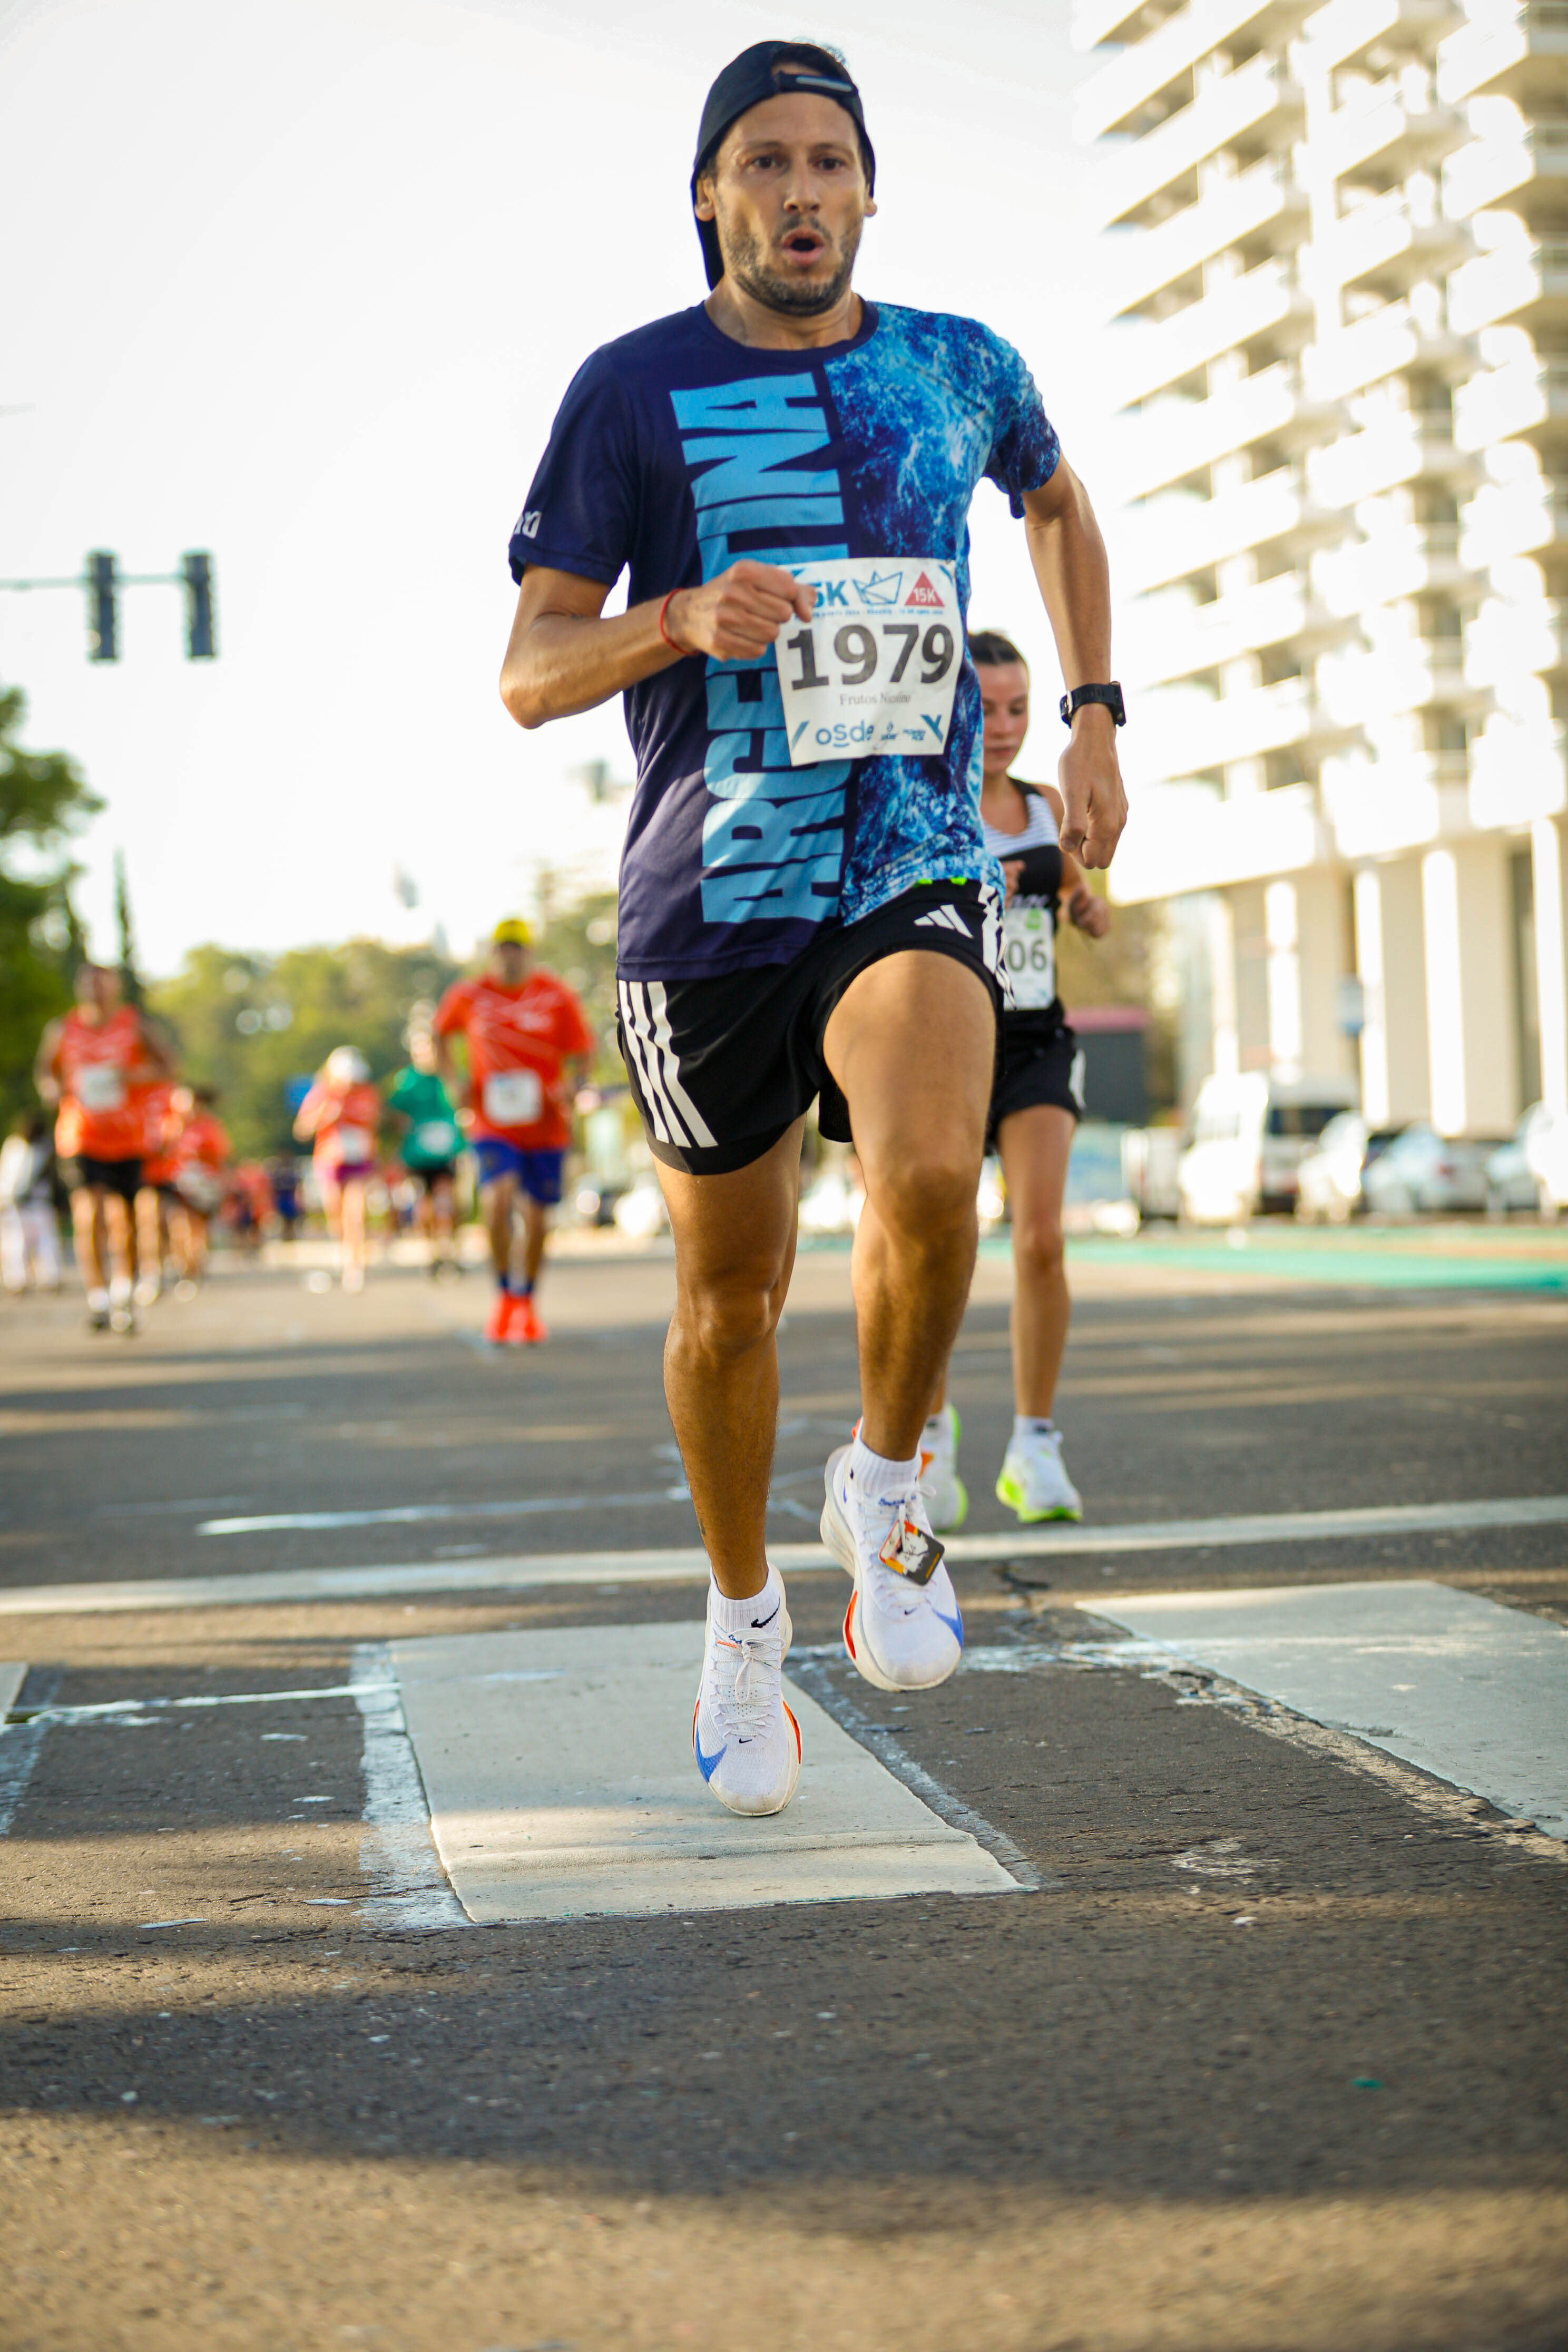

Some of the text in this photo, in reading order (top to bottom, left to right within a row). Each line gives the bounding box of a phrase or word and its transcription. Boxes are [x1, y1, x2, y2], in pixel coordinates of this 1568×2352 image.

[914, 587, 937, 603] 15K
[670, 371, 851, 923] ARGETINA
[787, 624, 954, 691] 1979
[840, 693, 878, 706] Frutos
[1007, 939, 1047, 973] 06
